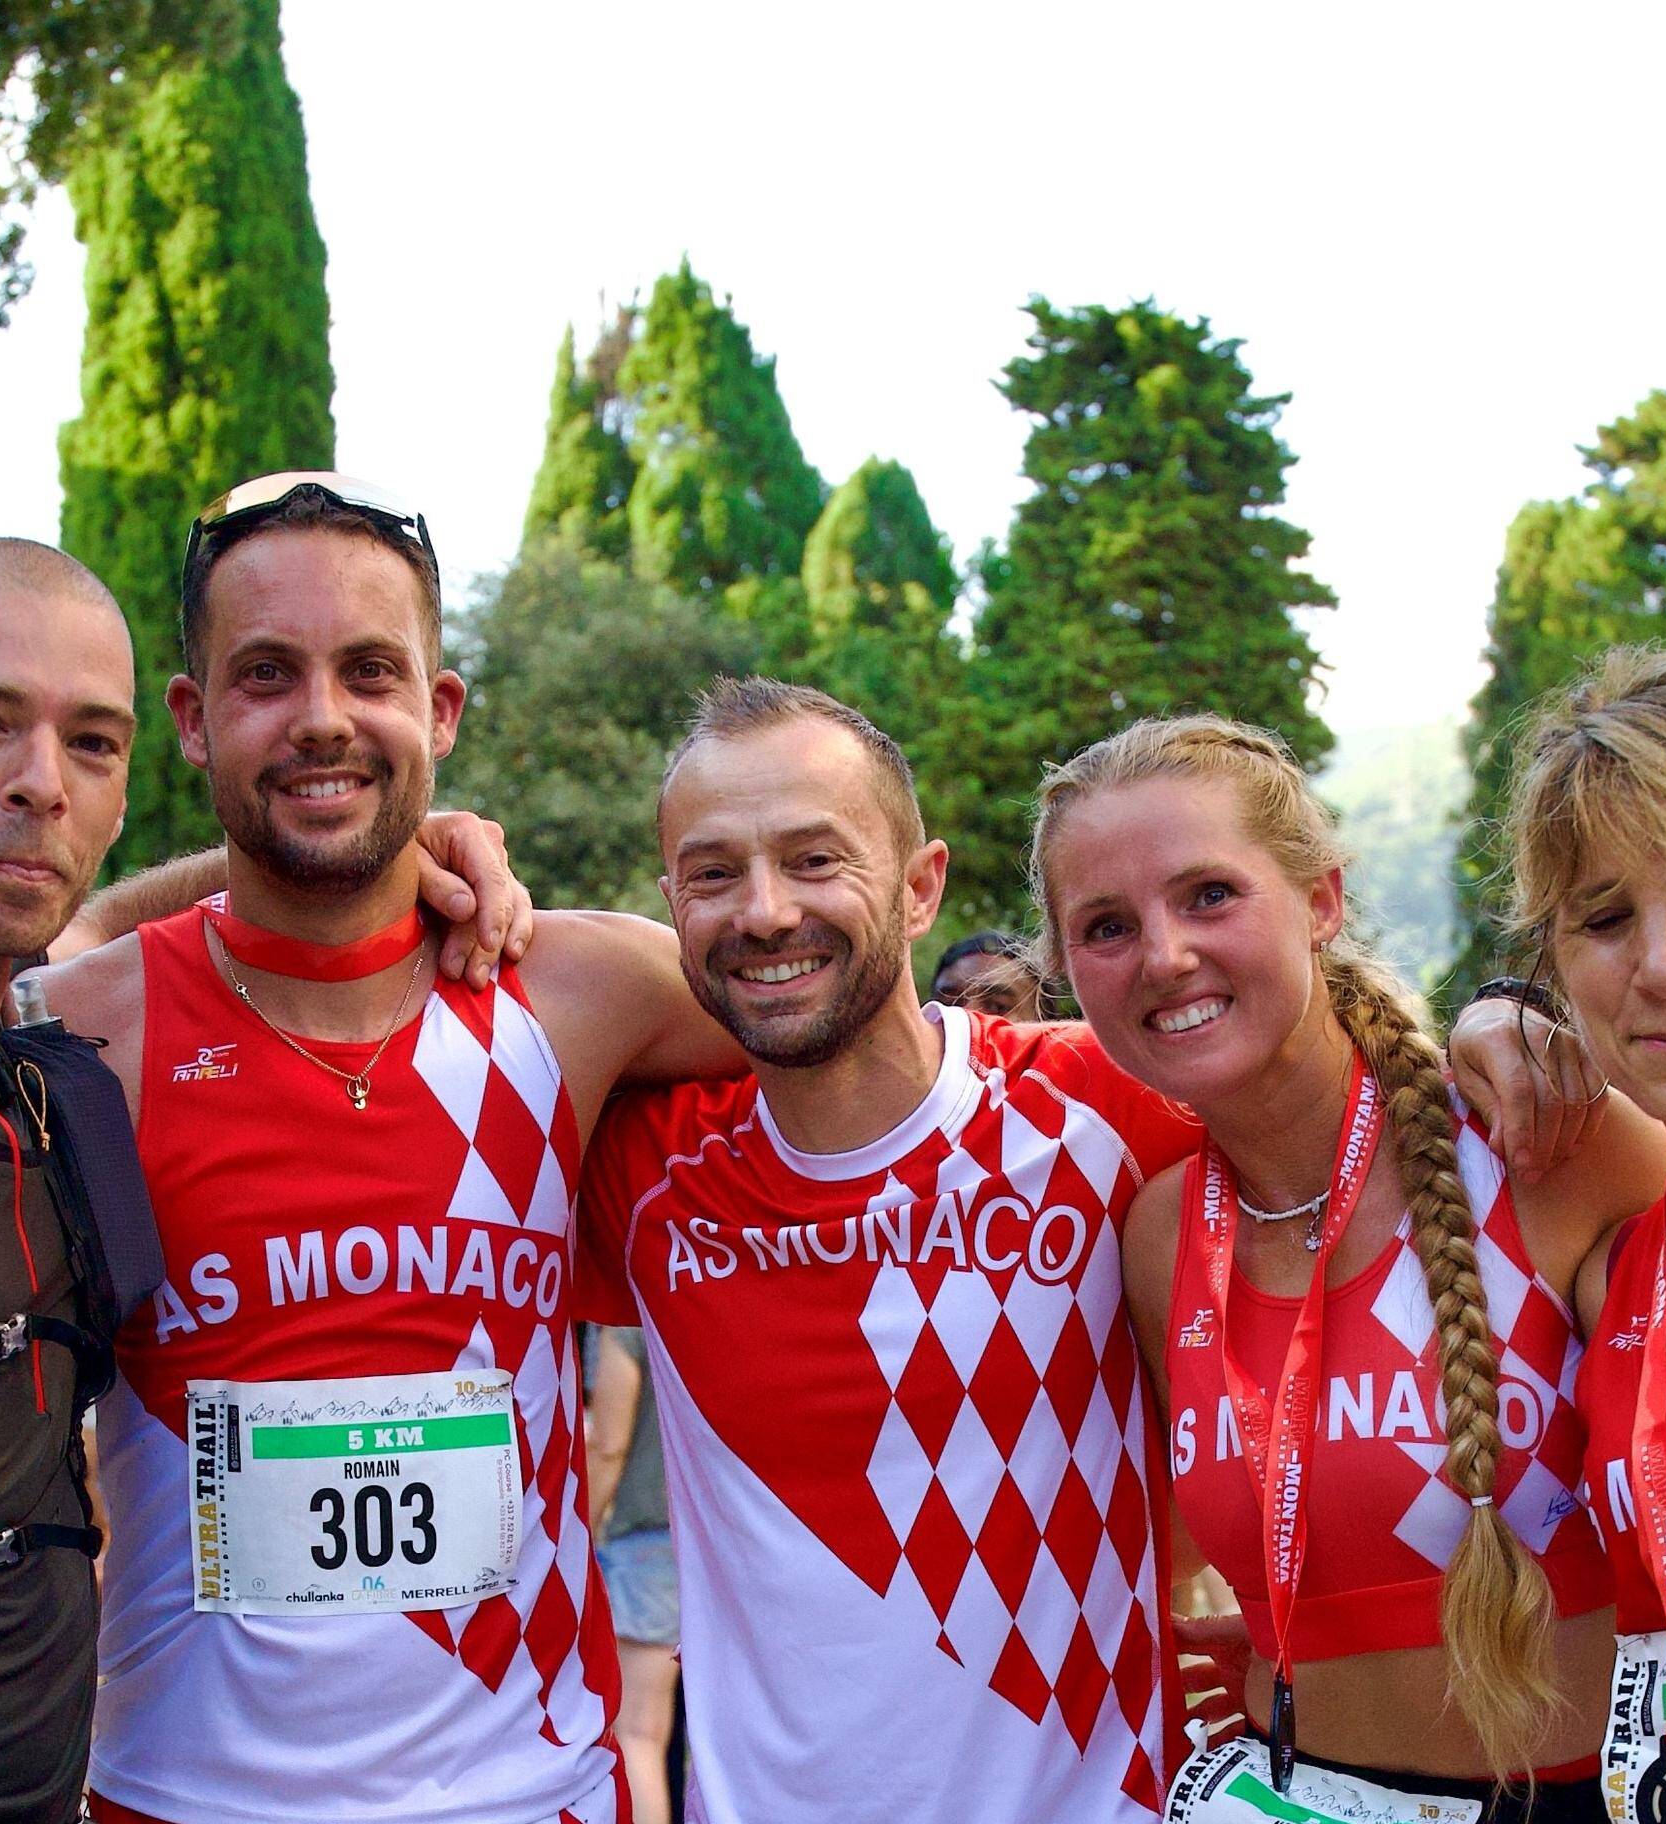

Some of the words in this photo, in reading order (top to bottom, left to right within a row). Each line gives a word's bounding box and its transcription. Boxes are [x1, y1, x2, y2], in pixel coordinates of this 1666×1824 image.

[668, 1217, 738, 1292] AS
[743, 1192, 1089, 1283] MONACO
[153, 1253, 239, 1345] AS
[265, 1226, 562, 1319] MONACO
[218, 1403, 226, 1502] MERCANTOUR
[343, 1459, 401, 1480] ROMAIN
[348, 1429, 364, 1450] 5
[374, 1426, 424, 1448] KM
[1171, 1407, 1198, 1482] S
[309, 1481, 438, 1571] 303
[286, 1589, 345, 1602] chullanka
[401, 1586, 470, 1600] MERRELL
